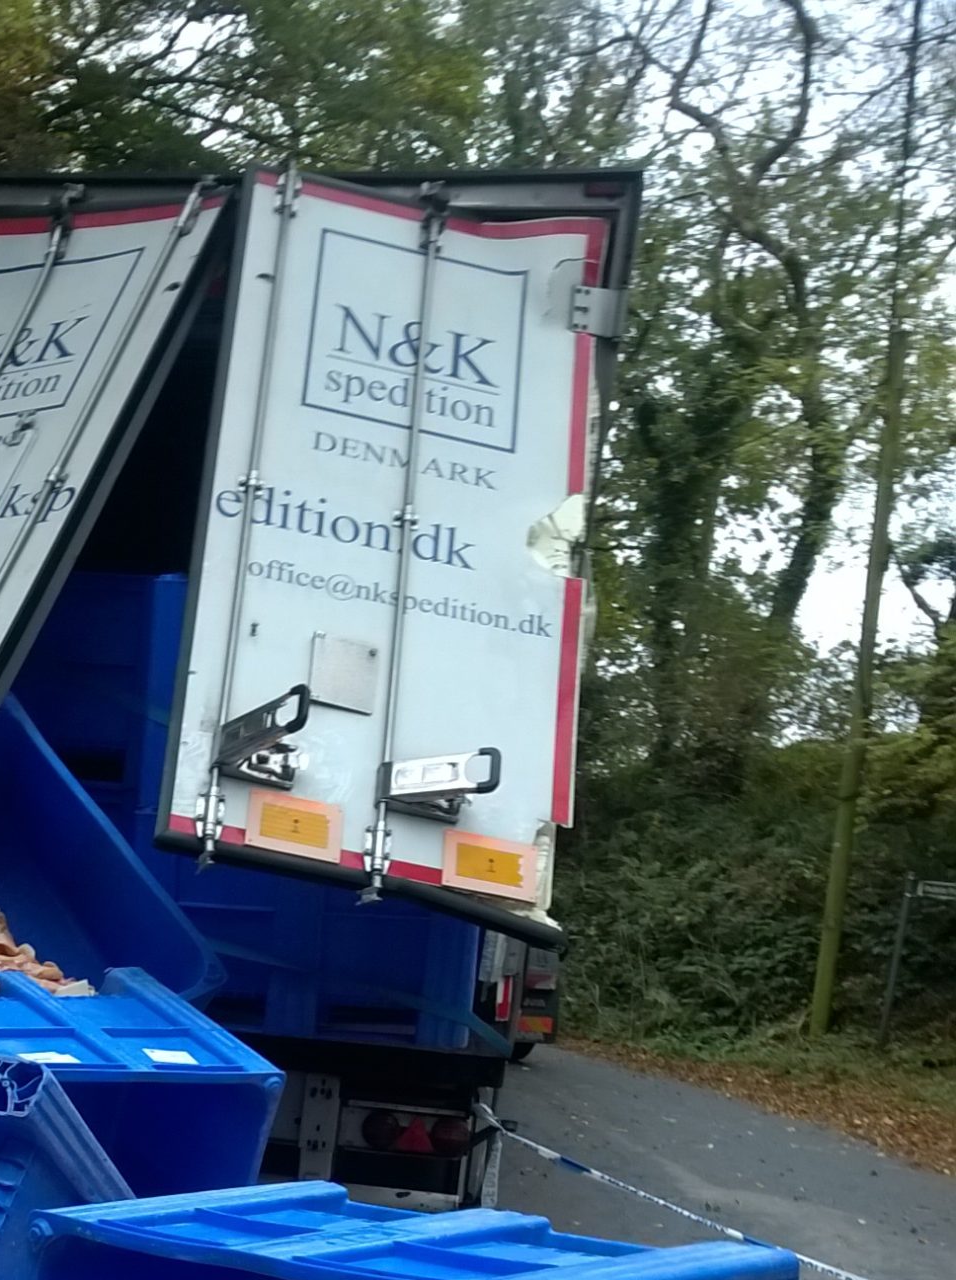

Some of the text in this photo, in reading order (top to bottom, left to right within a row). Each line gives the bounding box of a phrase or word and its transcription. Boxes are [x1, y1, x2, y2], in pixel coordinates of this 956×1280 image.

[335, 303, 501, 389] N&K
[324, 367, 497, 429] spedtion
[246, 559, 554, 638] office@nkspedition.dk
